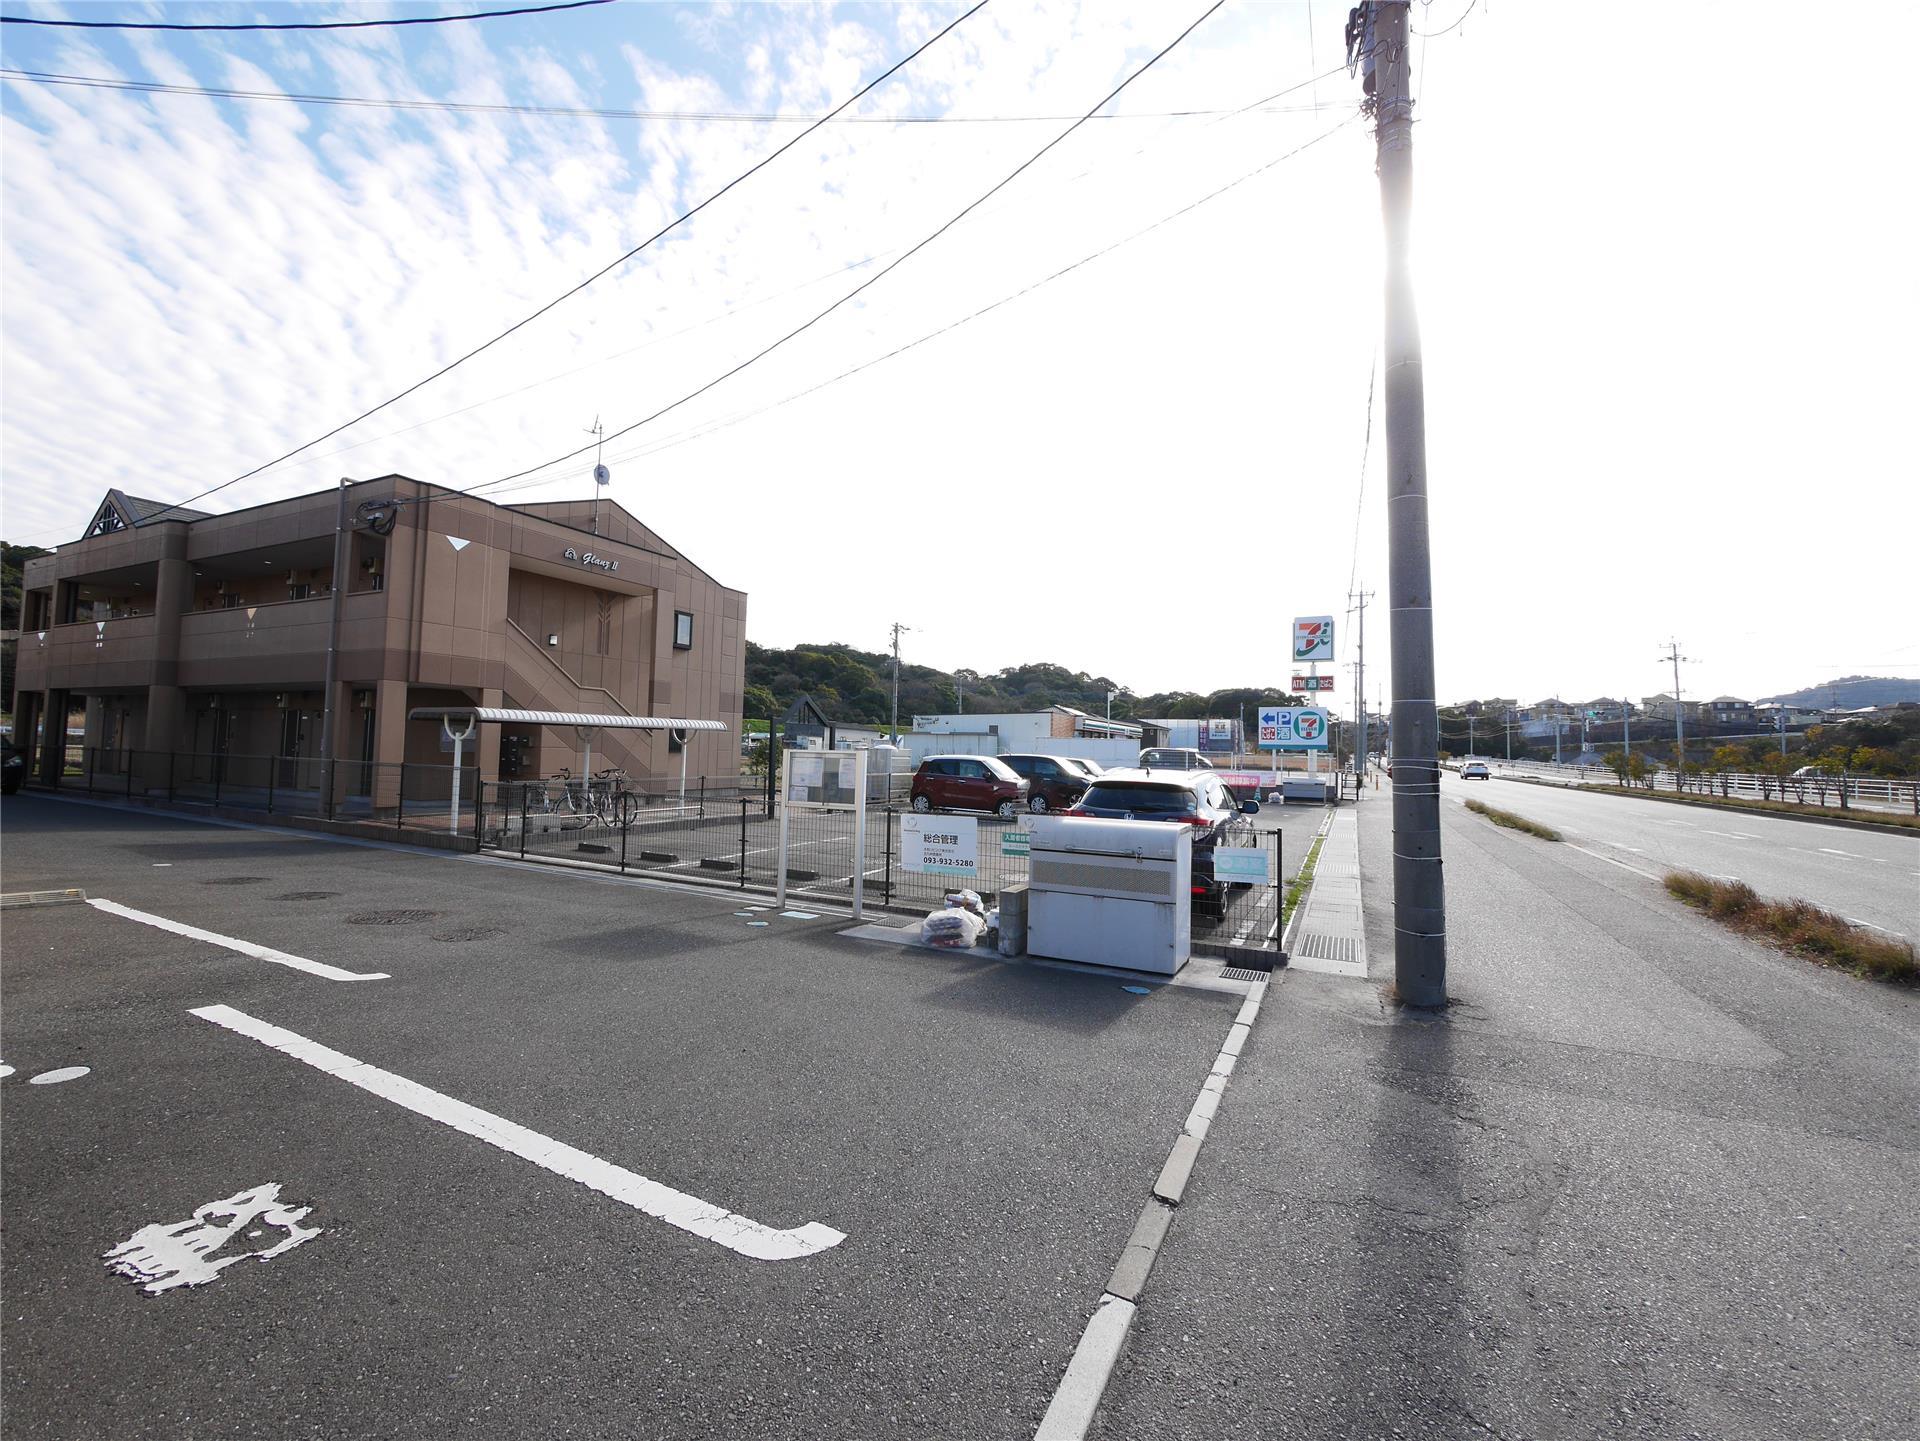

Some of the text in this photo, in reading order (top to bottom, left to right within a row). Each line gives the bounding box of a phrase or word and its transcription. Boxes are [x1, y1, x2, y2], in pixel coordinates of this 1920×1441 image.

[583, 553, 610, 570] Glanz
[1292, 679, 1305, 689] ATM
[1278, 712, 1291, 725] P
[1277, 727, 1291, 740] 酒
[923, 833, 959, 845] 総合管理
[923, 856, 974, 867] 093-932-5280
